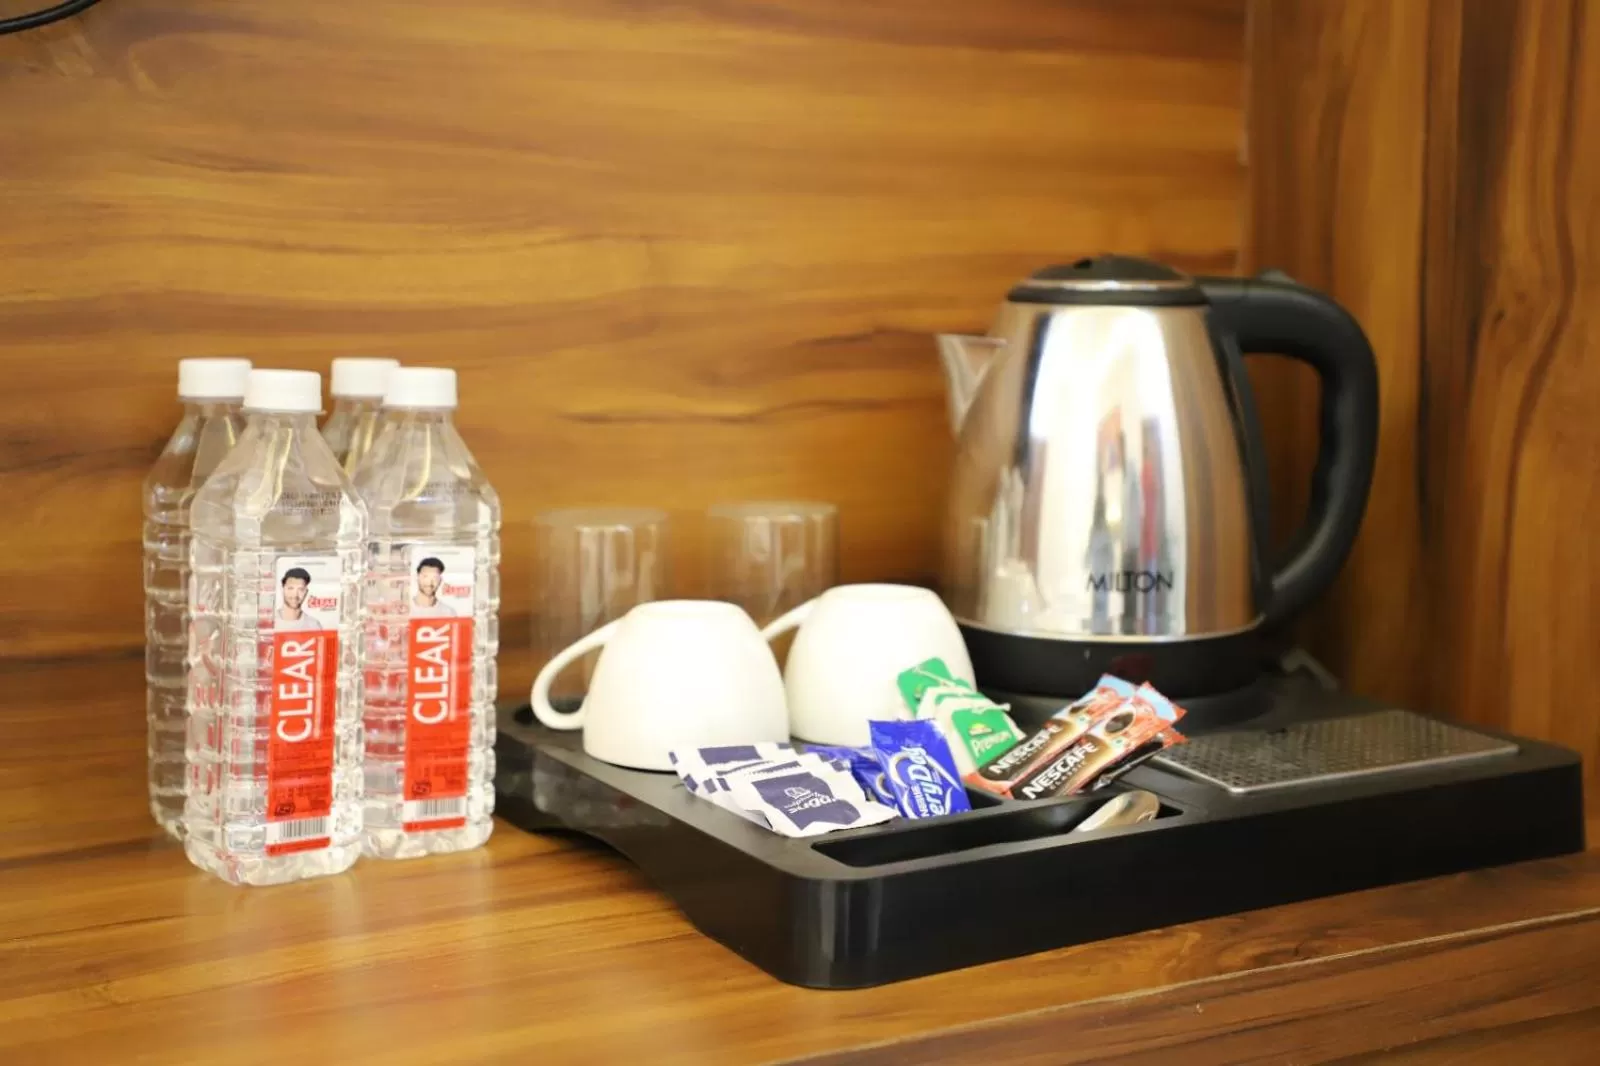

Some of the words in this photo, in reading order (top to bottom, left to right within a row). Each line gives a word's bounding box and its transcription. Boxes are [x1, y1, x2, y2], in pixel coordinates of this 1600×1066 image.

[1086, 570, 1174, 593] MILTON
[276, 636, 317, 743] CLEAR
[412, 622, 450, 725] CLEAR
